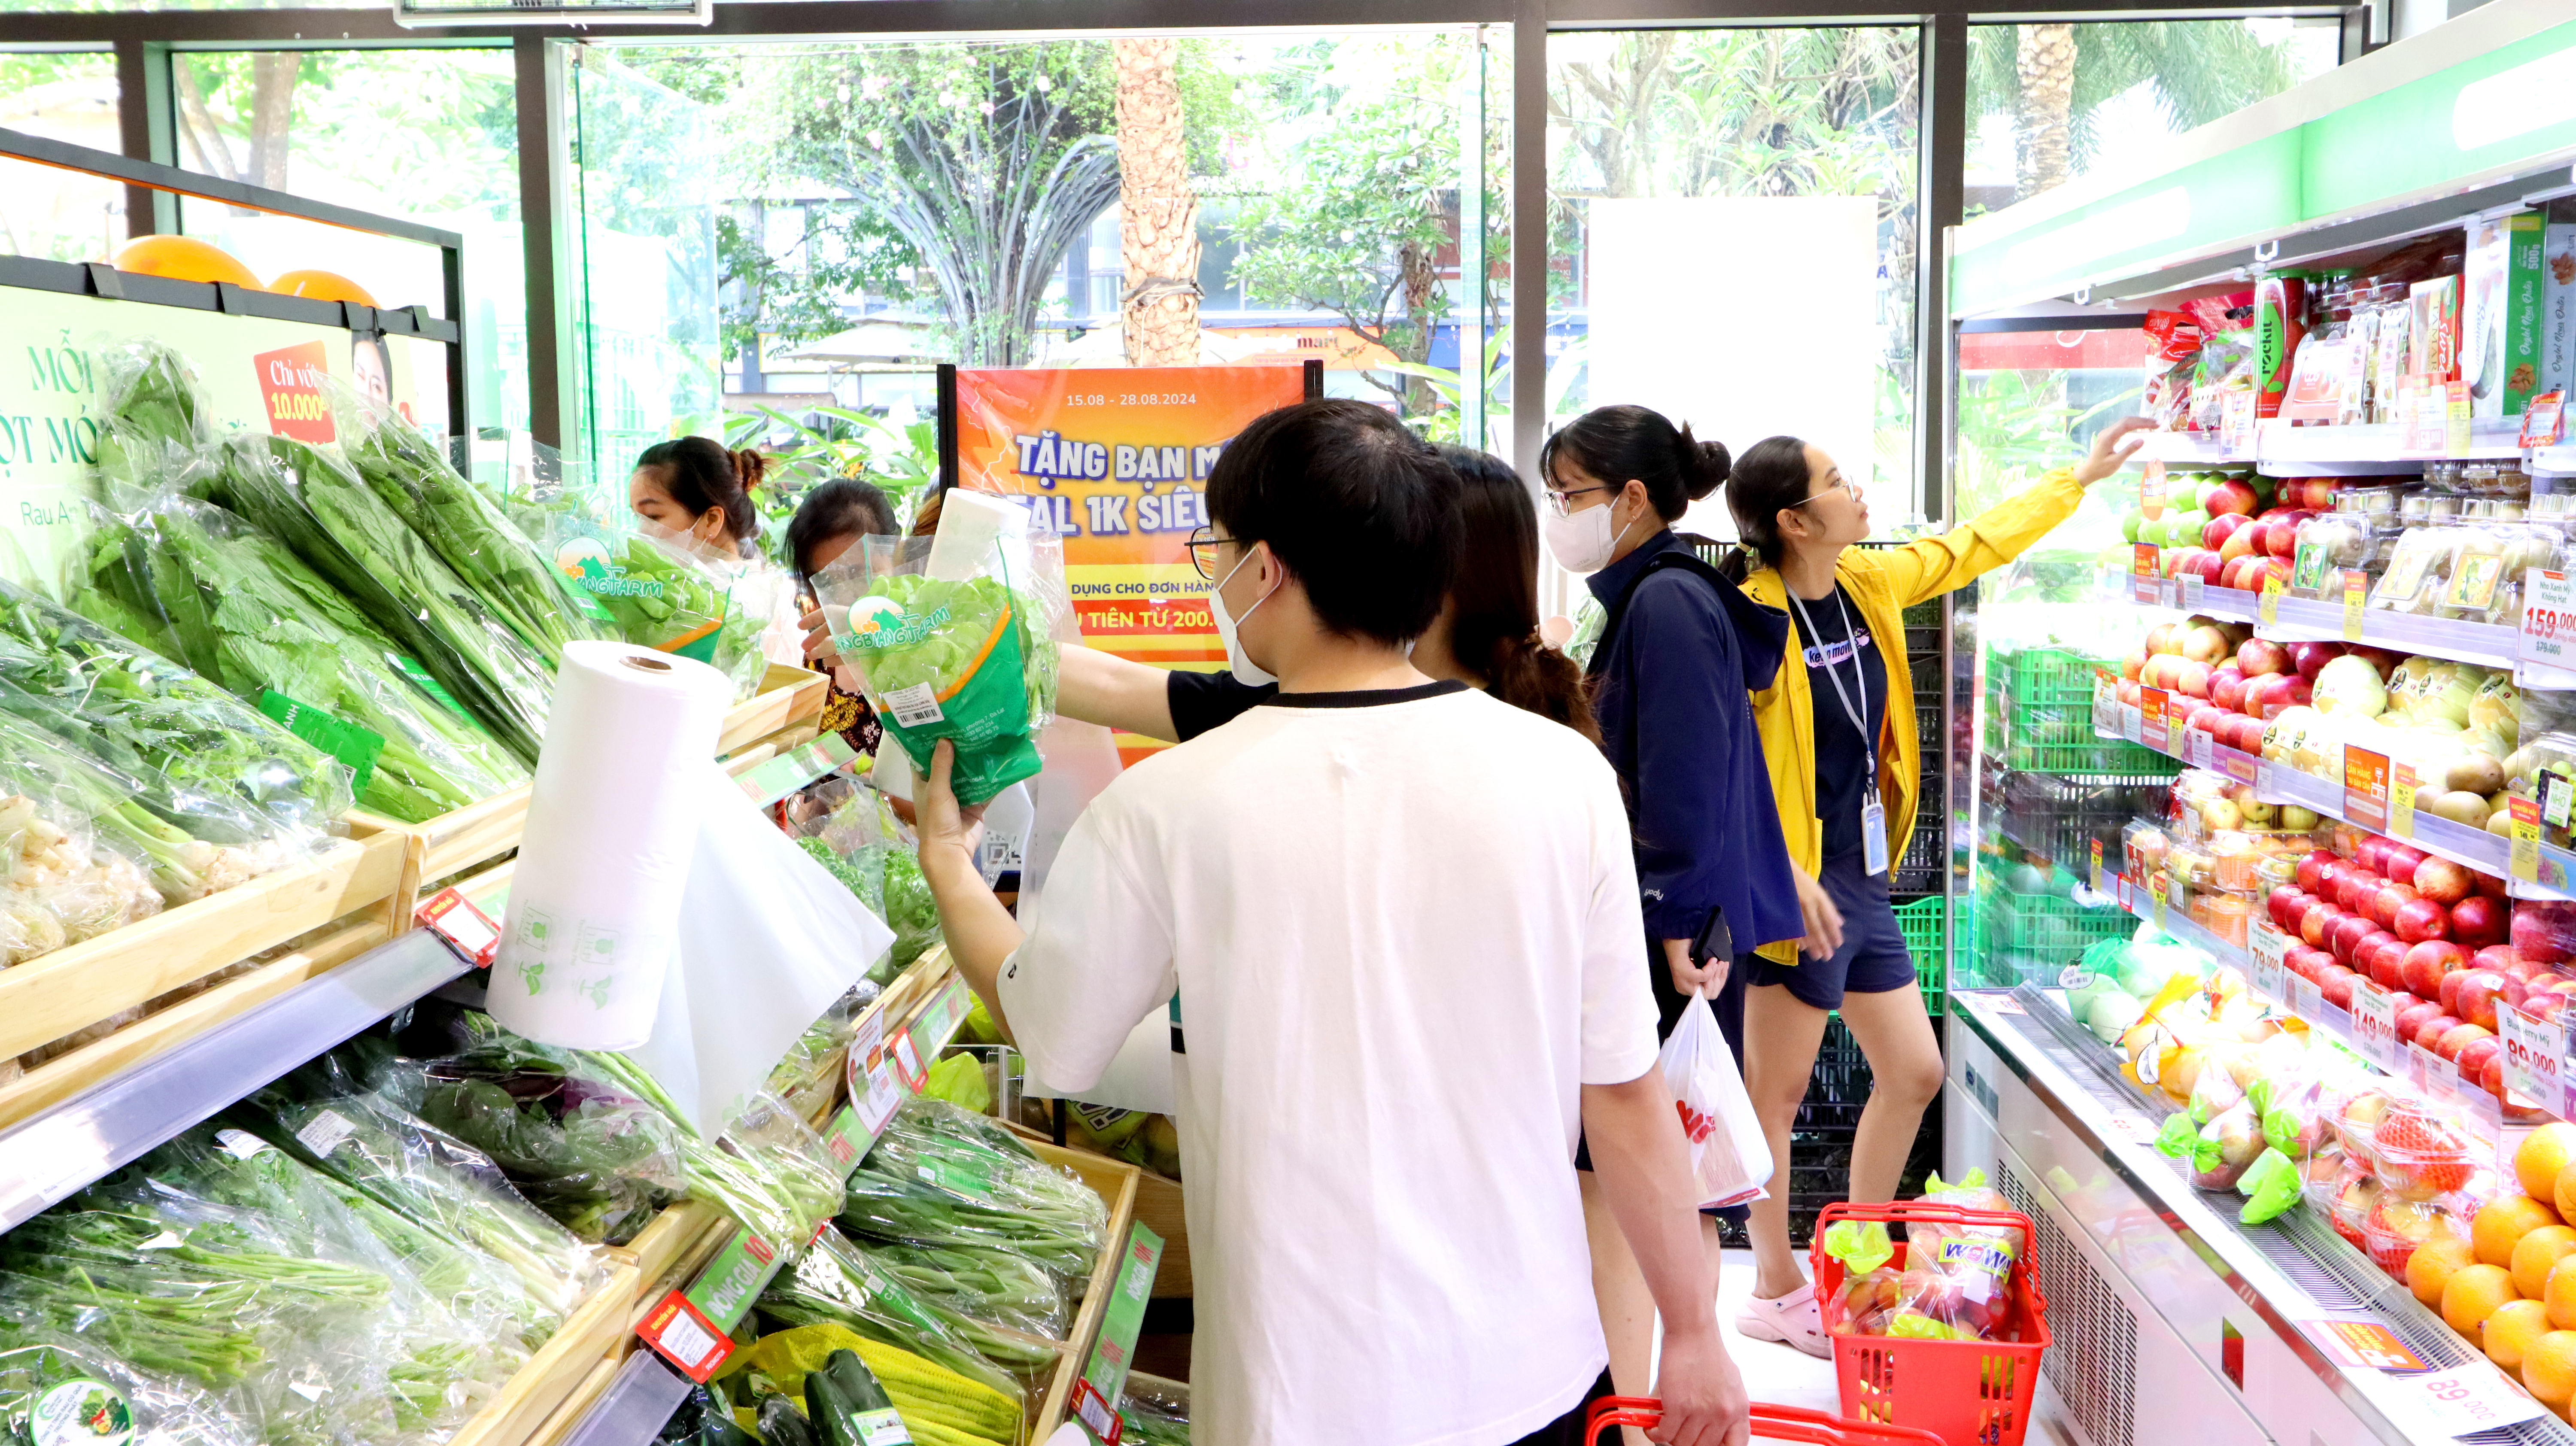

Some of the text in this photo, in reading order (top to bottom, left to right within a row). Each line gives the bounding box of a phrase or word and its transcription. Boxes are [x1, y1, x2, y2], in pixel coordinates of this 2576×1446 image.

[2262, 320, 2273, 374] rockit
[270, 359, 295, 386] Chỉ
[1066, 395, 1105, 406] 15.08
[1120, 393, 1197, 406] 28.08.2024
[0, 408, 33, 478] ỘT
[1016, 430, 1106, 486] TẶNG
[1117, 445, 1185, 490] BẠN
[20, 502, 53, 526] Rau
[1086, 496, 1128, 532] 1K
[1072, 580, 1214, 597] DỤNG CHO ĐƠN HÀN
[2540, 581, 2549, 590] Nho
[2550, 583, 2562, 592] Xanh
[1087, 607, 1134, 628] TIÊN
[1139, 607, 1169, 627] TỪ
[1173, 611, 1215, 627] 200.
[2551, 793, 2566, 808] NHO
[1644, 888, 1664, 901] yody
[2353, 1006, 2394, 1042] 149.000
[2506, 1017, 2538, 1042] Blueerry
[2507, 1038, 2556, 1076] 89.000
[743, 1236, 775, 1266] 10
